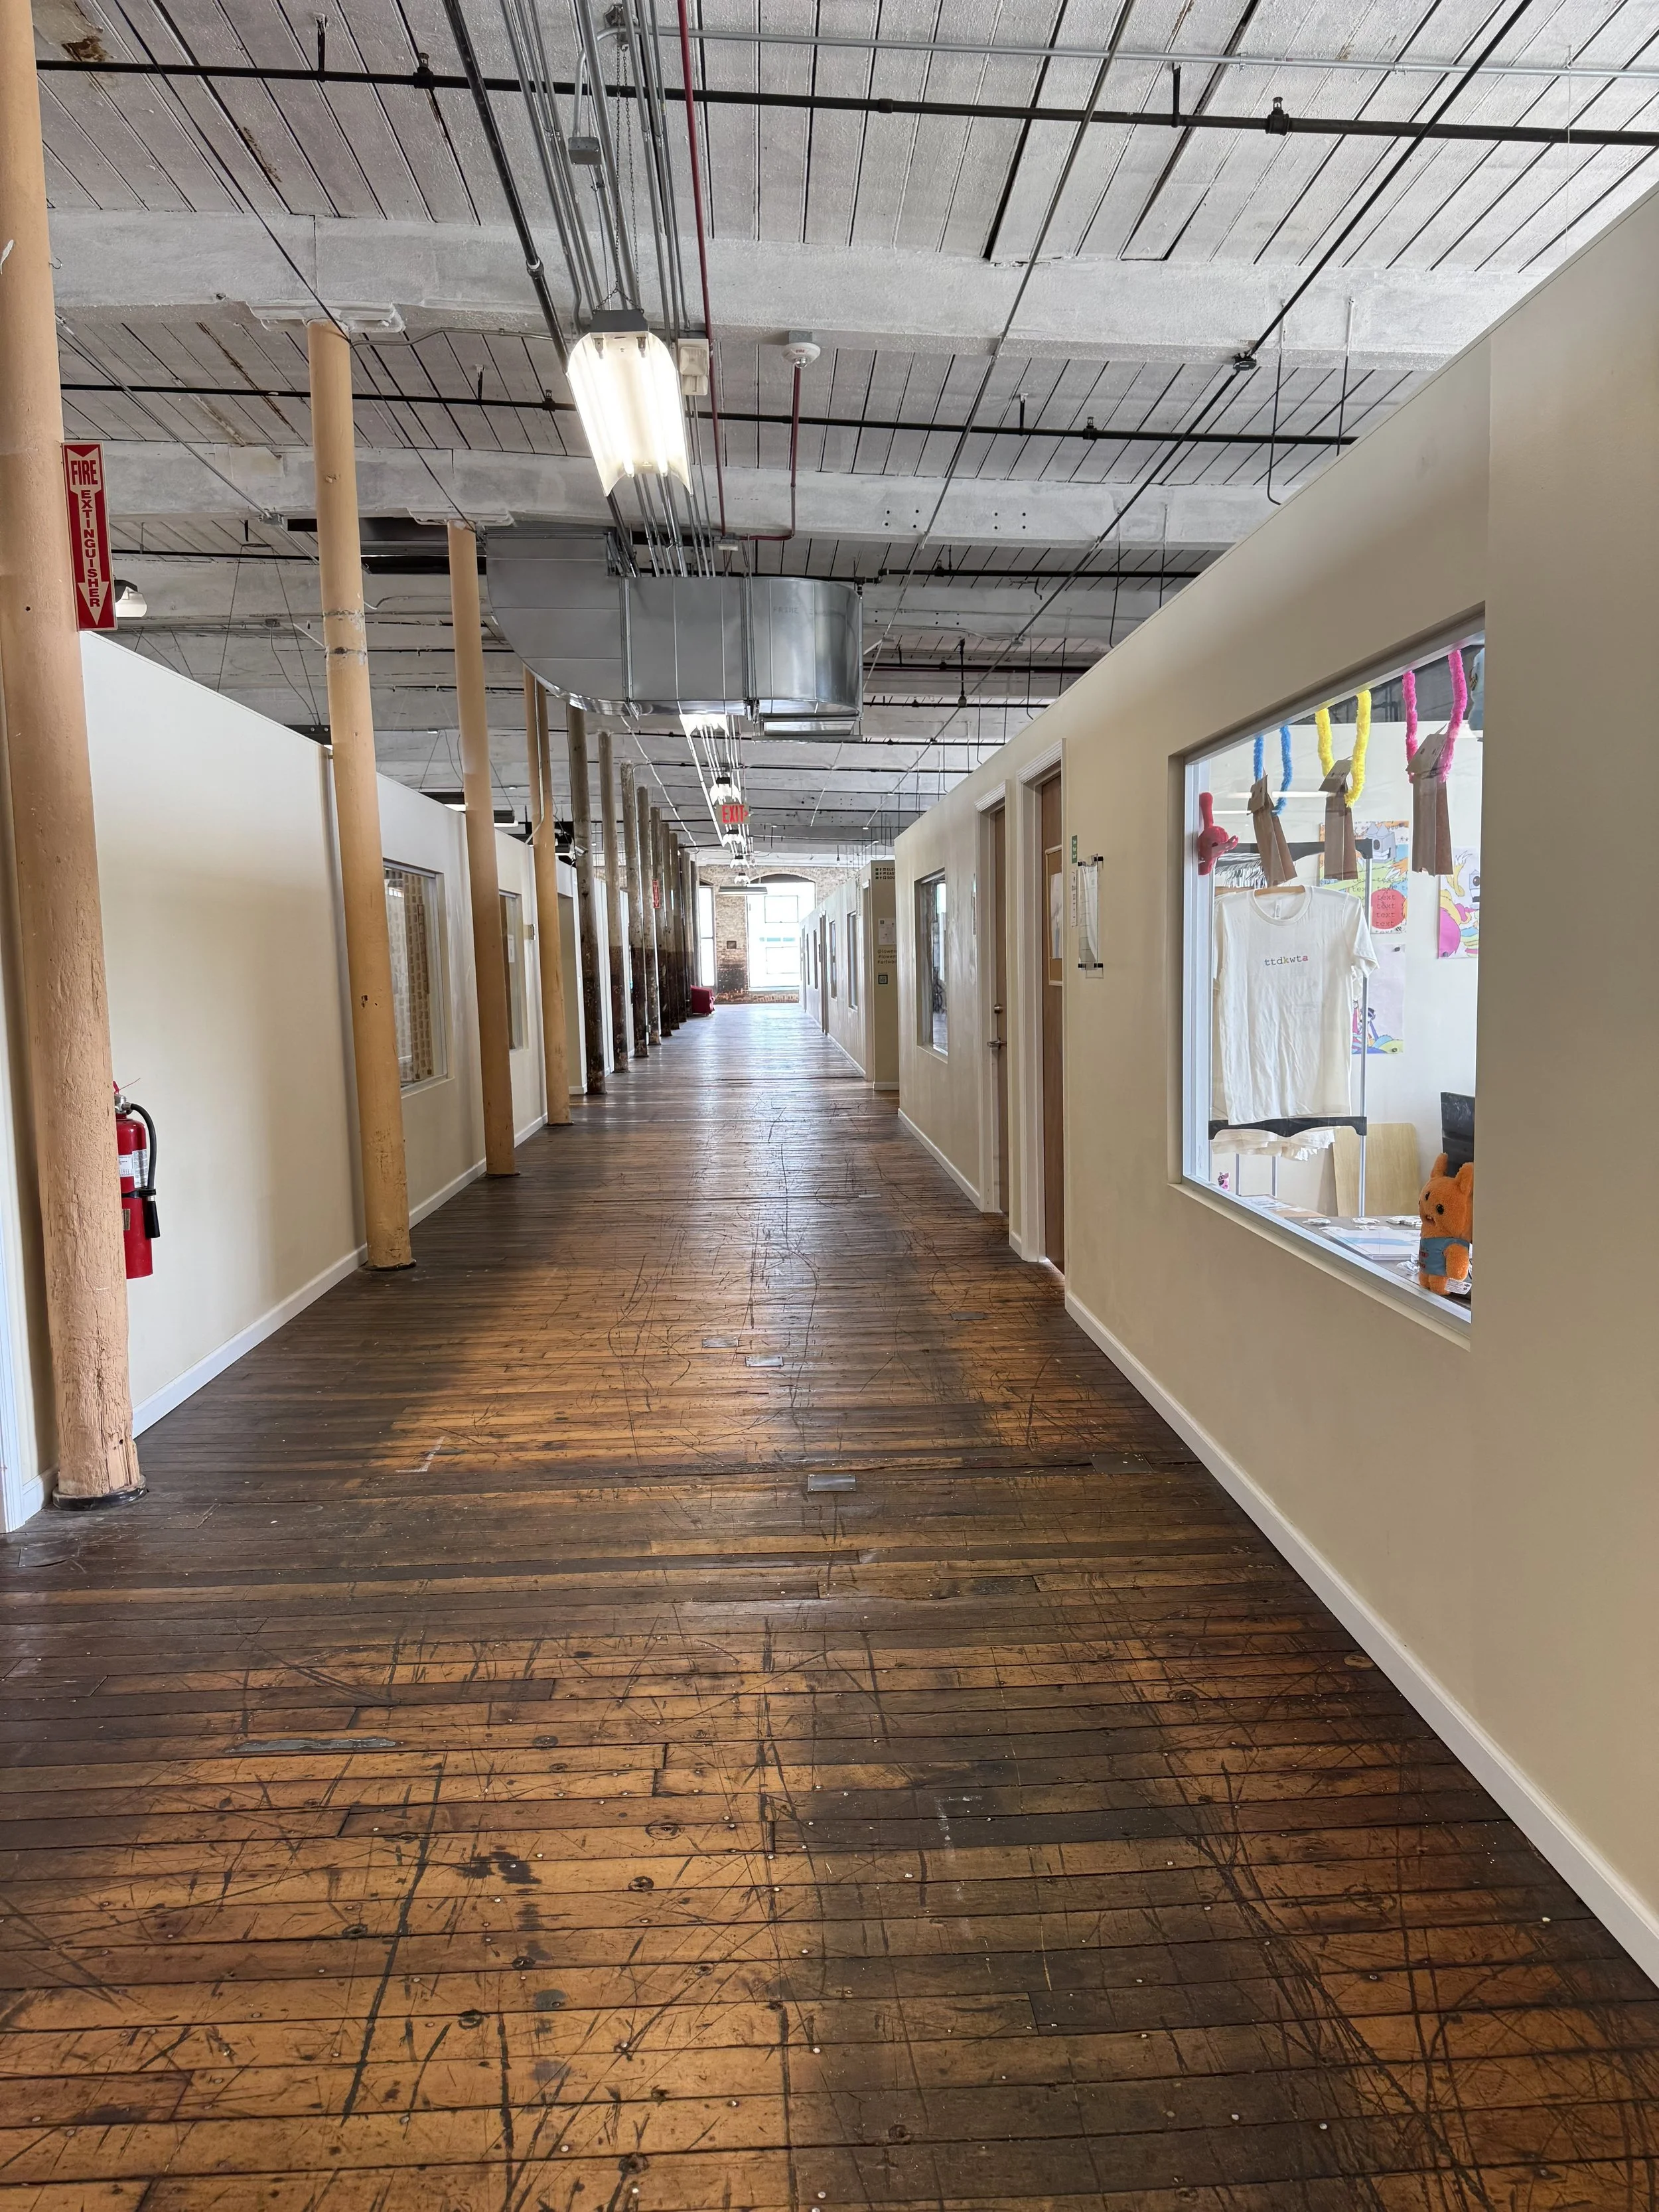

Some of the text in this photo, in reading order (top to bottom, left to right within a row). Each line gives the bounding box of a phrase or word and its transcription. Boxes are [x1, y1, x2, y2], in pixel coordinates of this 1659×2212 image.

[70, 460, 98, 485] FIRE
[80, 490, 100, 607] EXTINGUISHER
[722, 804, 744, 824] EXIT
[1264, 956, 1309, 966] ttdkwta
